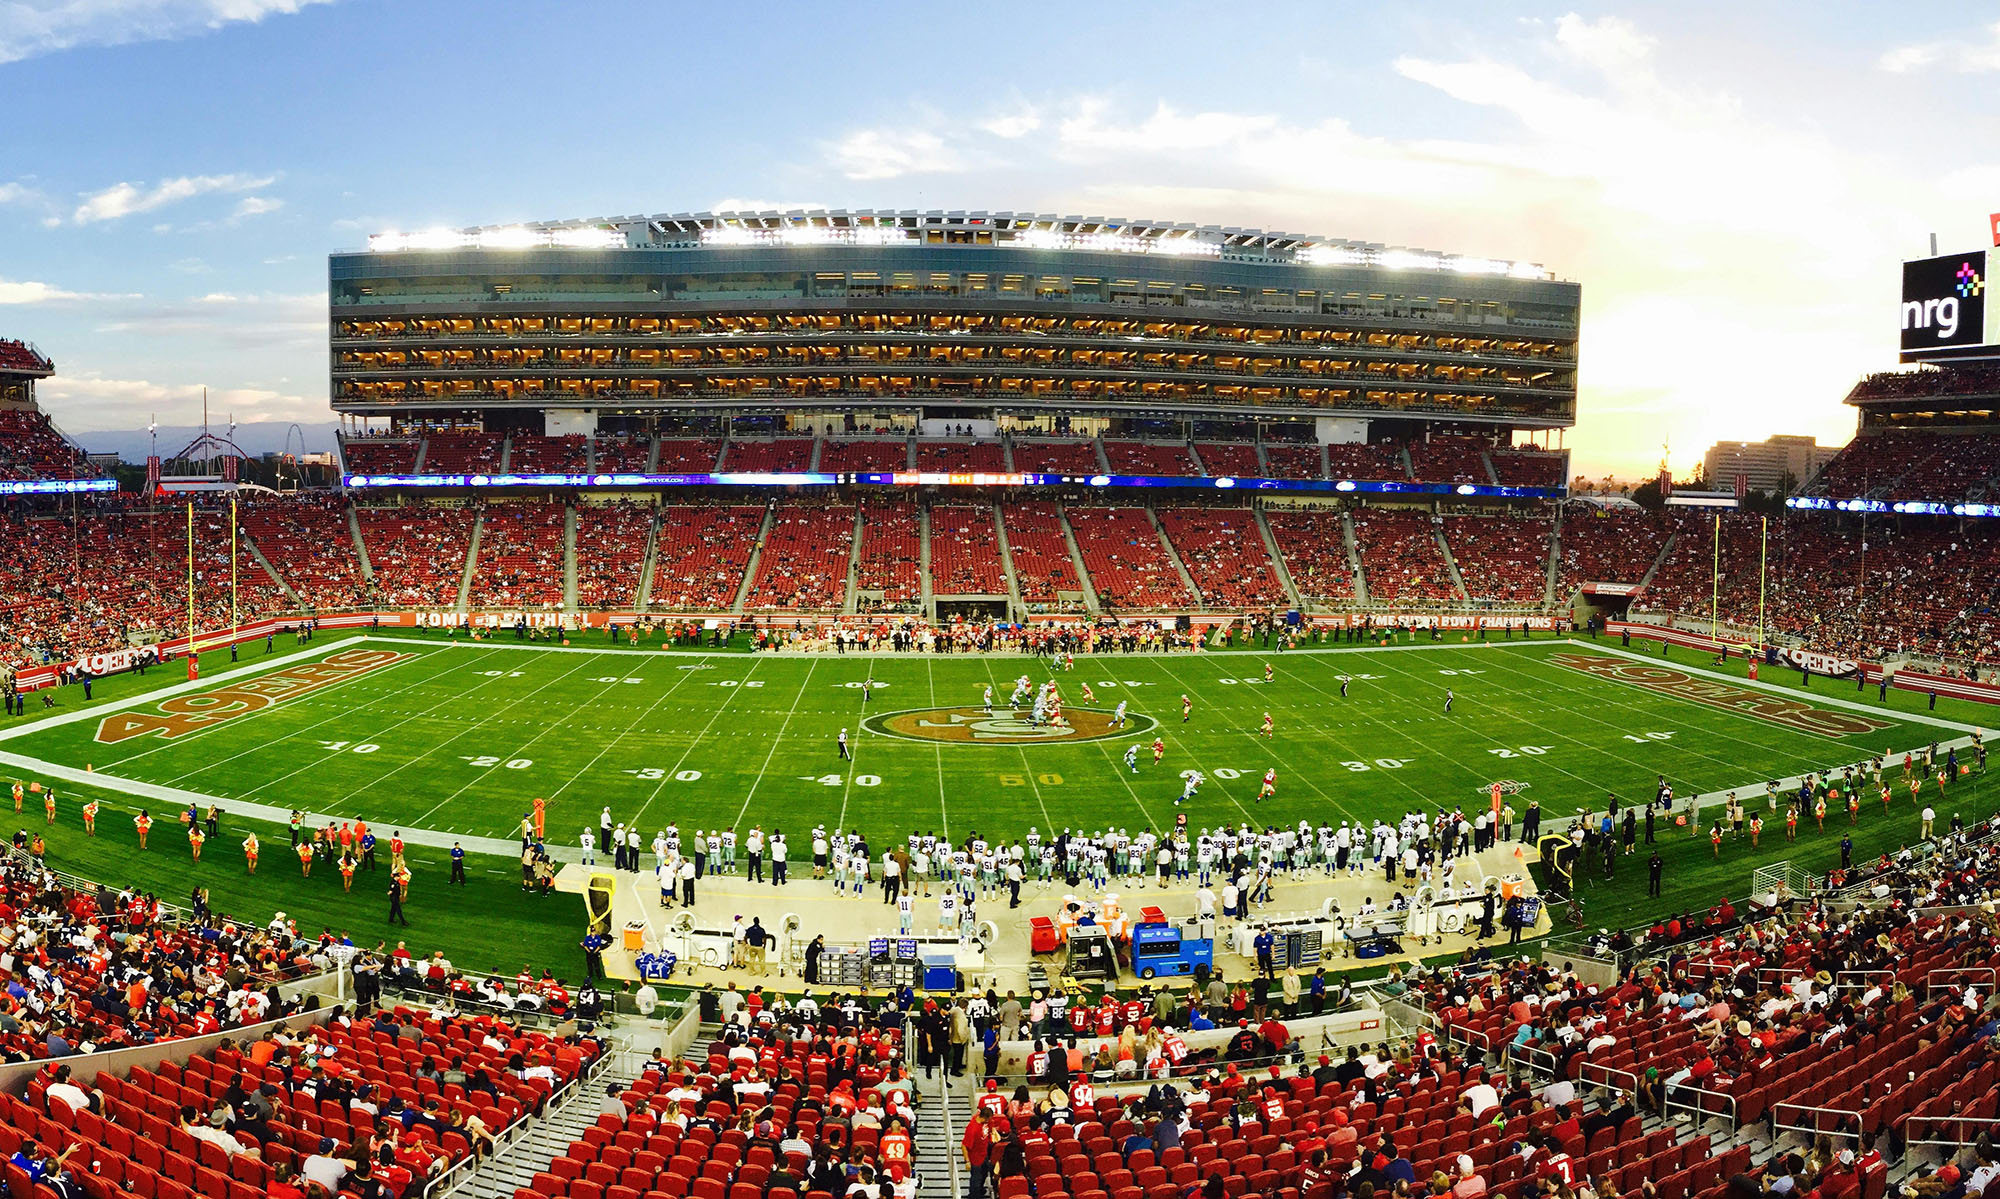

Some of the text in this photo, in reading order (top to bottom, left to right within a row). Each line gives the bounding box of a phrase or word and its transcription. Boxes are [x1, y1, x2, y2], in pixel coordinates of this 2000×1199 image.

[1901, 296, 1959, 339] nrg
[416, 612, 469, 627] HOME
[1480, 616, 1551, 628] CHAMPIONS
[93, 648, 422, 744] 49ERS
[1544, 652, 1902, 738] 49ERS
[1623, 731, 1668, 744] 10
[322, 741, 381, 754] 10
[1488, 746, 1546, 759] 20
[469, 755, 533, 769] 20
[1340, 758, 1403, 772] 30
[637, 768, 702, 781] 30
[817, 774, 882, 787] 40
[1000, 774, 1064, 786] 50
[1178, 814, 1187, 825] 3
[584, 838, 590, 847] 5
[856, 862, 862, 871] 6
[1512, 885, 1521, 895] G
[900, 901, 908, 911] 11
[942, 900, 954, 909] 32
[964, 910, 973, 920] 13
[580, 992, 595, 1005] 54
[803, 1009, 812, 1021] 9
[846, 1010, 854, 1021] 9
[972, 1007, 985, 1019] 24
[1052, 1007, 1064, 1019] 88
[1127, 1010, 1140, 1022] 52
[1074, 1014, 1085, 1026] 11
[196, 1022, 205, 1034] 7
[1169, 1044, 1187, 1061] 16
[1074, 1089, 1094, 1107] 94
[886, 1142, 905, 1159] 49
[1557, 1161, 1572, 1184] 7
